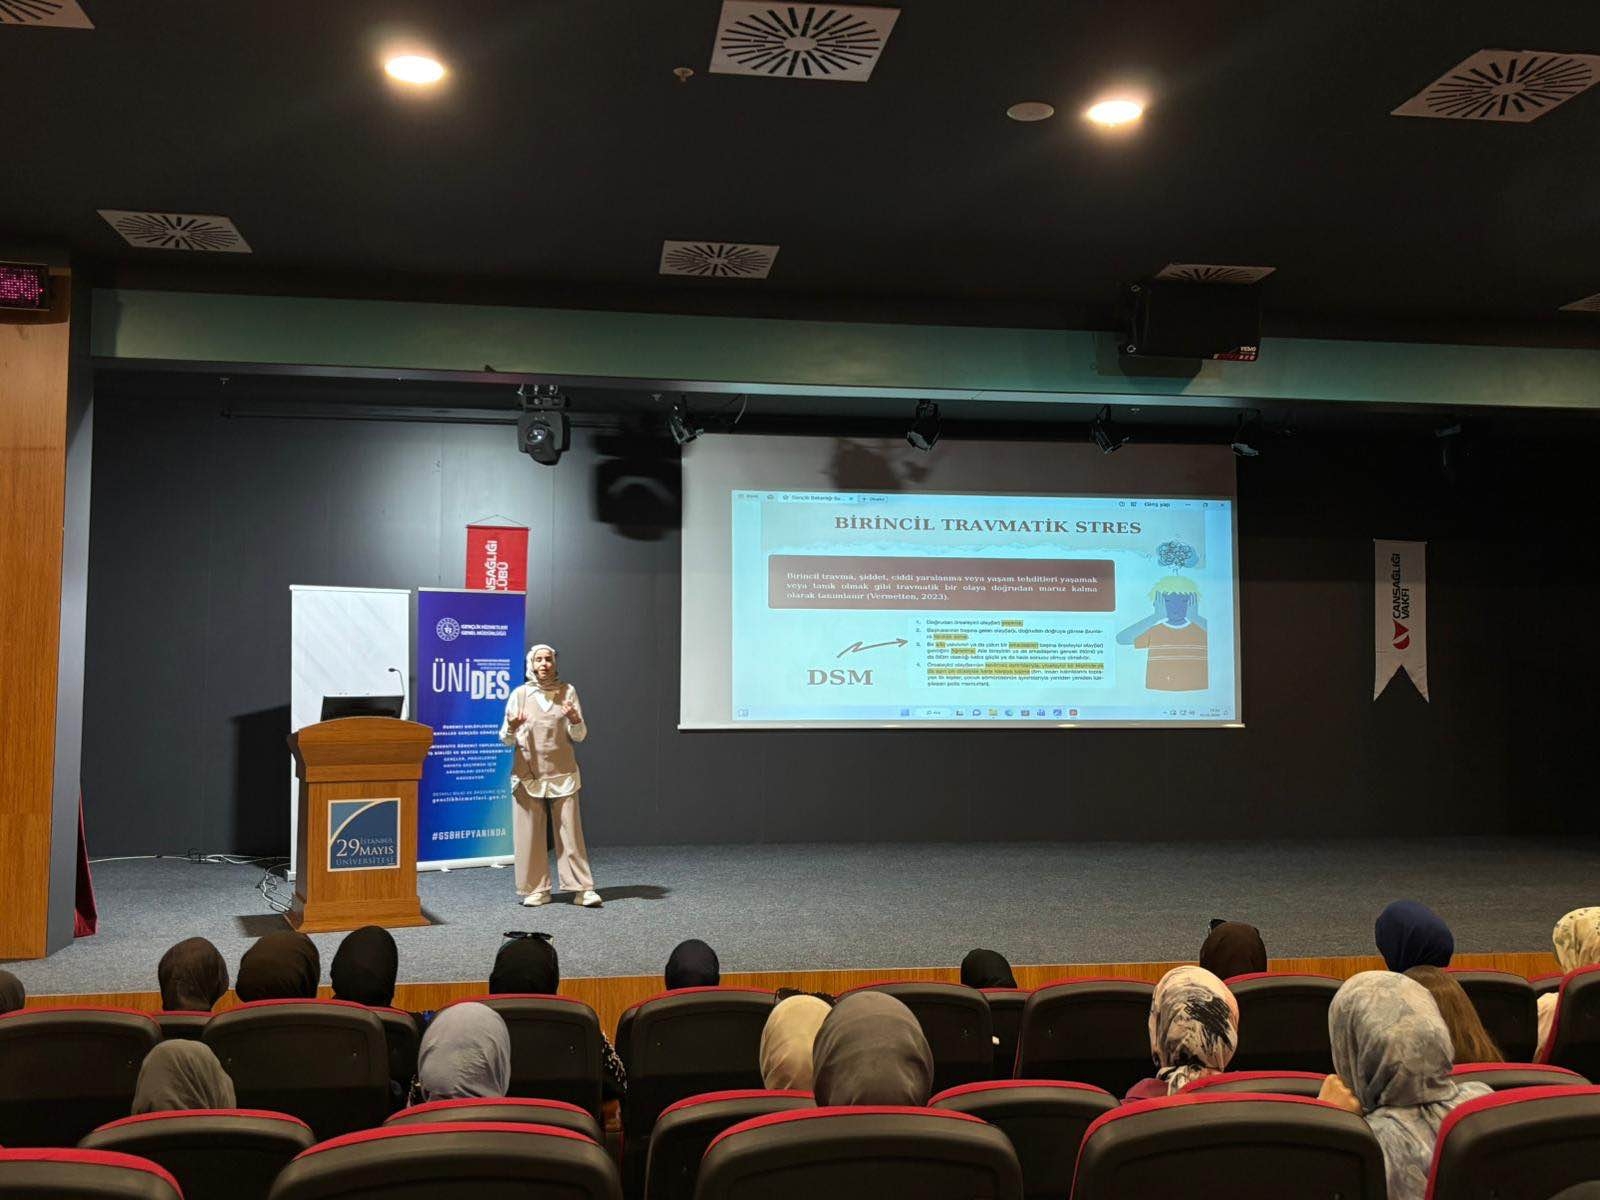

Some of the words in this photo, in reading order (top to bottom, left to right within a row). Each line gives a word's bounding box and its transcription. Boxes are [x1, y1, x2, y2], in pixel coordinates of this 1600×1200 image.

[835, 515, 935, 531] BİRİNCİL
[941, 517, 1070, 533] TRAVMATİK
[1075, 520, 1142, 534] STRES
[484, 540, 498, 591] NSAĞLIĞI
[786, 572, 820, 580] Birincil
[822, 573, 857, 582] travma,
[891, 574, 914, 582] ciddi
[916, 575, 962, 584] yaralanma
[964, 576, 985, 584] veya
[987, 576, 1015, 584] yaşam
[1017, 575, 1058, 584] tehditleri
[1060, 576, 1098, 585] yaşamak
[786, 583, 807, 591] veya
[841, 582, 869, 591] olmak
[874, 583, 891, 592] gibi
[896, 583, 939, 591] travmatik
[962, 584, 986, 592] olaya
[991, 585, 1034, 593] doğrudan
[1072, 585, 1098, 593] kalma
[1391, 553, 1401, 620] CANSAĞLIĞI
[786, 591, 815, 600] olarak
[867, 592, 919, 601] (Vermetten,
[921, 592, 949, 601] 2023).
[1401, 588, 1410, 620] VAKFI
[807, 669, 874, 686] DSM
[432, 828, 507, 841] #GSBHEPYANINDA
[336, 838, 360, 857] 29
[360, 845, 394, 856] MAYIS
